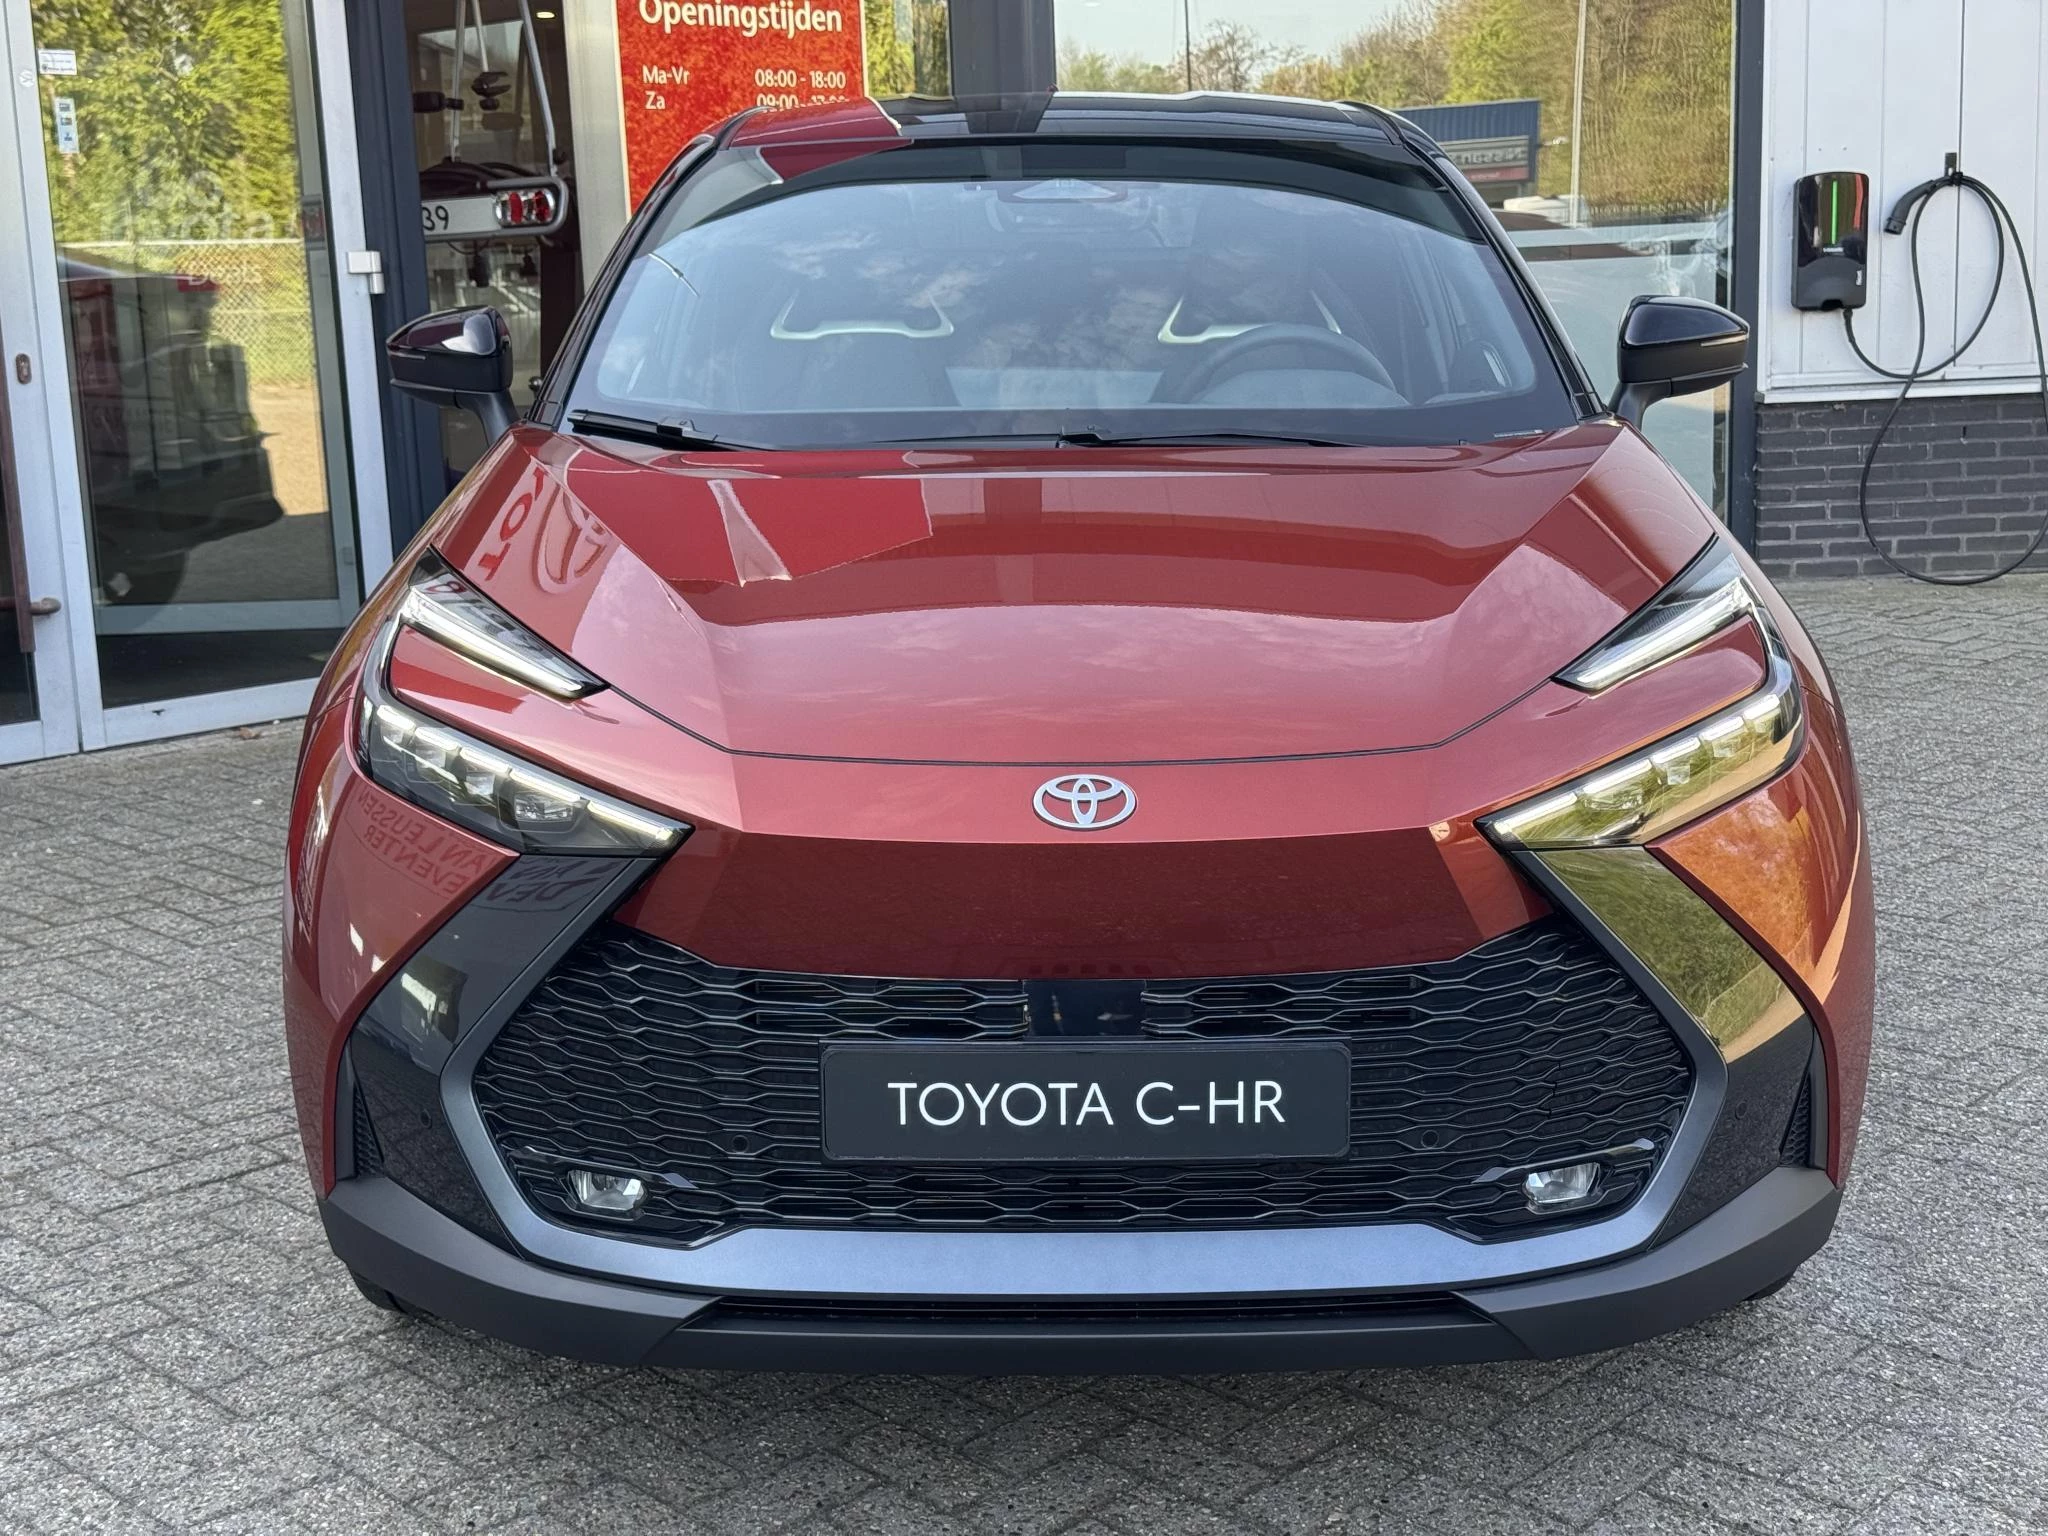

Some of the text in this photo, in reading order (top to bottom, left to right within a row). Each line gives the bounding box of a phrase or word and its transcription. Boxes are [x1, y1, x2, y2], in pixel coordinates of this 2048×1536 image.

[639, 0, 842, 39] Openingstijden
[642, 65, 690, 85] Ma-Vr
[754, 68, 797, 88] 08:00
[809, 70, 847, 89] 18:00
[645, 90, 666, 110] Za
[887, 1080, 1287, 1126] TOYOTA C-HR
